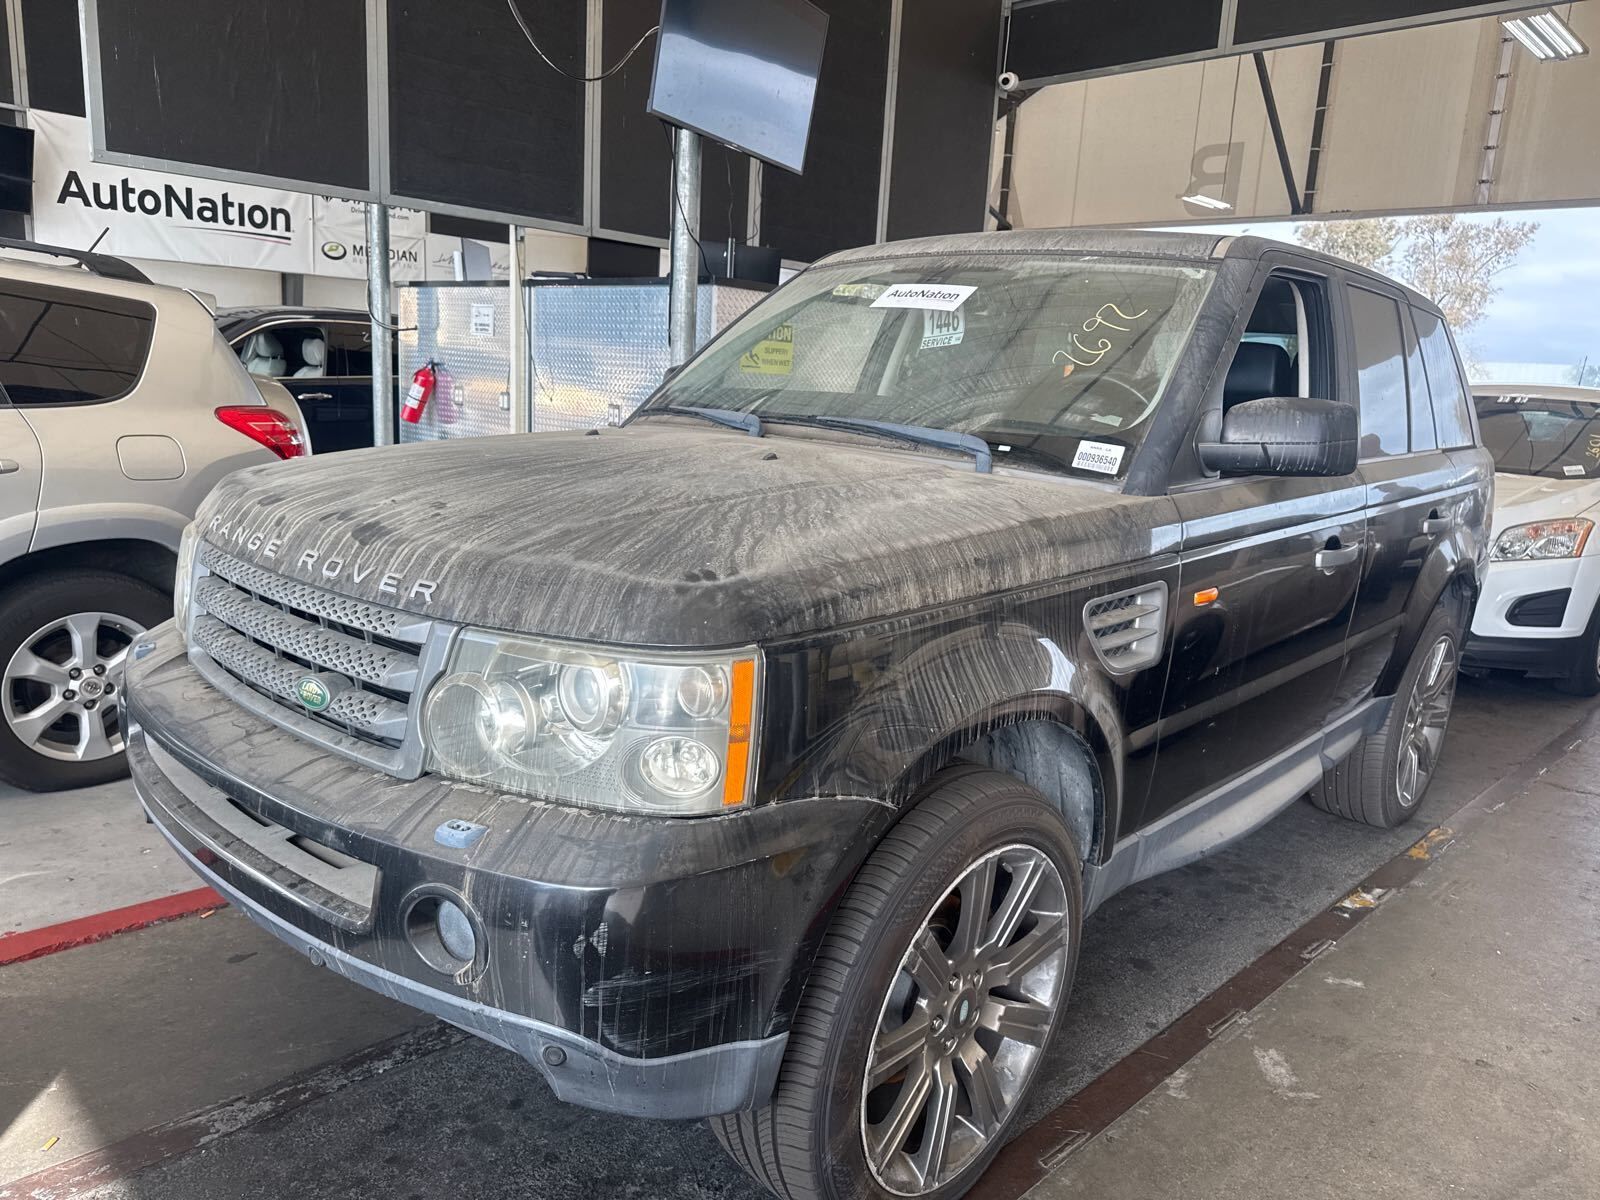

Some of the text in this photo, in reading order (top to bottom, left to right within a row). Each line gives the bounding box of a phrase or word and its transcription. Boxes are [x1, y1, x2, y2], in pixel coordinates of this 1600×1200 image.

[56, 170, 292, 233] AutoNation
[352, 244, 418, 263] MEDIAN
[887, 288, 961, 301] AutoNation
[929, 308, 961, 335] 1446
[922, 335, 954, 349] SERVICE
[1077, 451, 1118, 467] 000936540
[208, 514, 439, 604] RANGE ROVER
